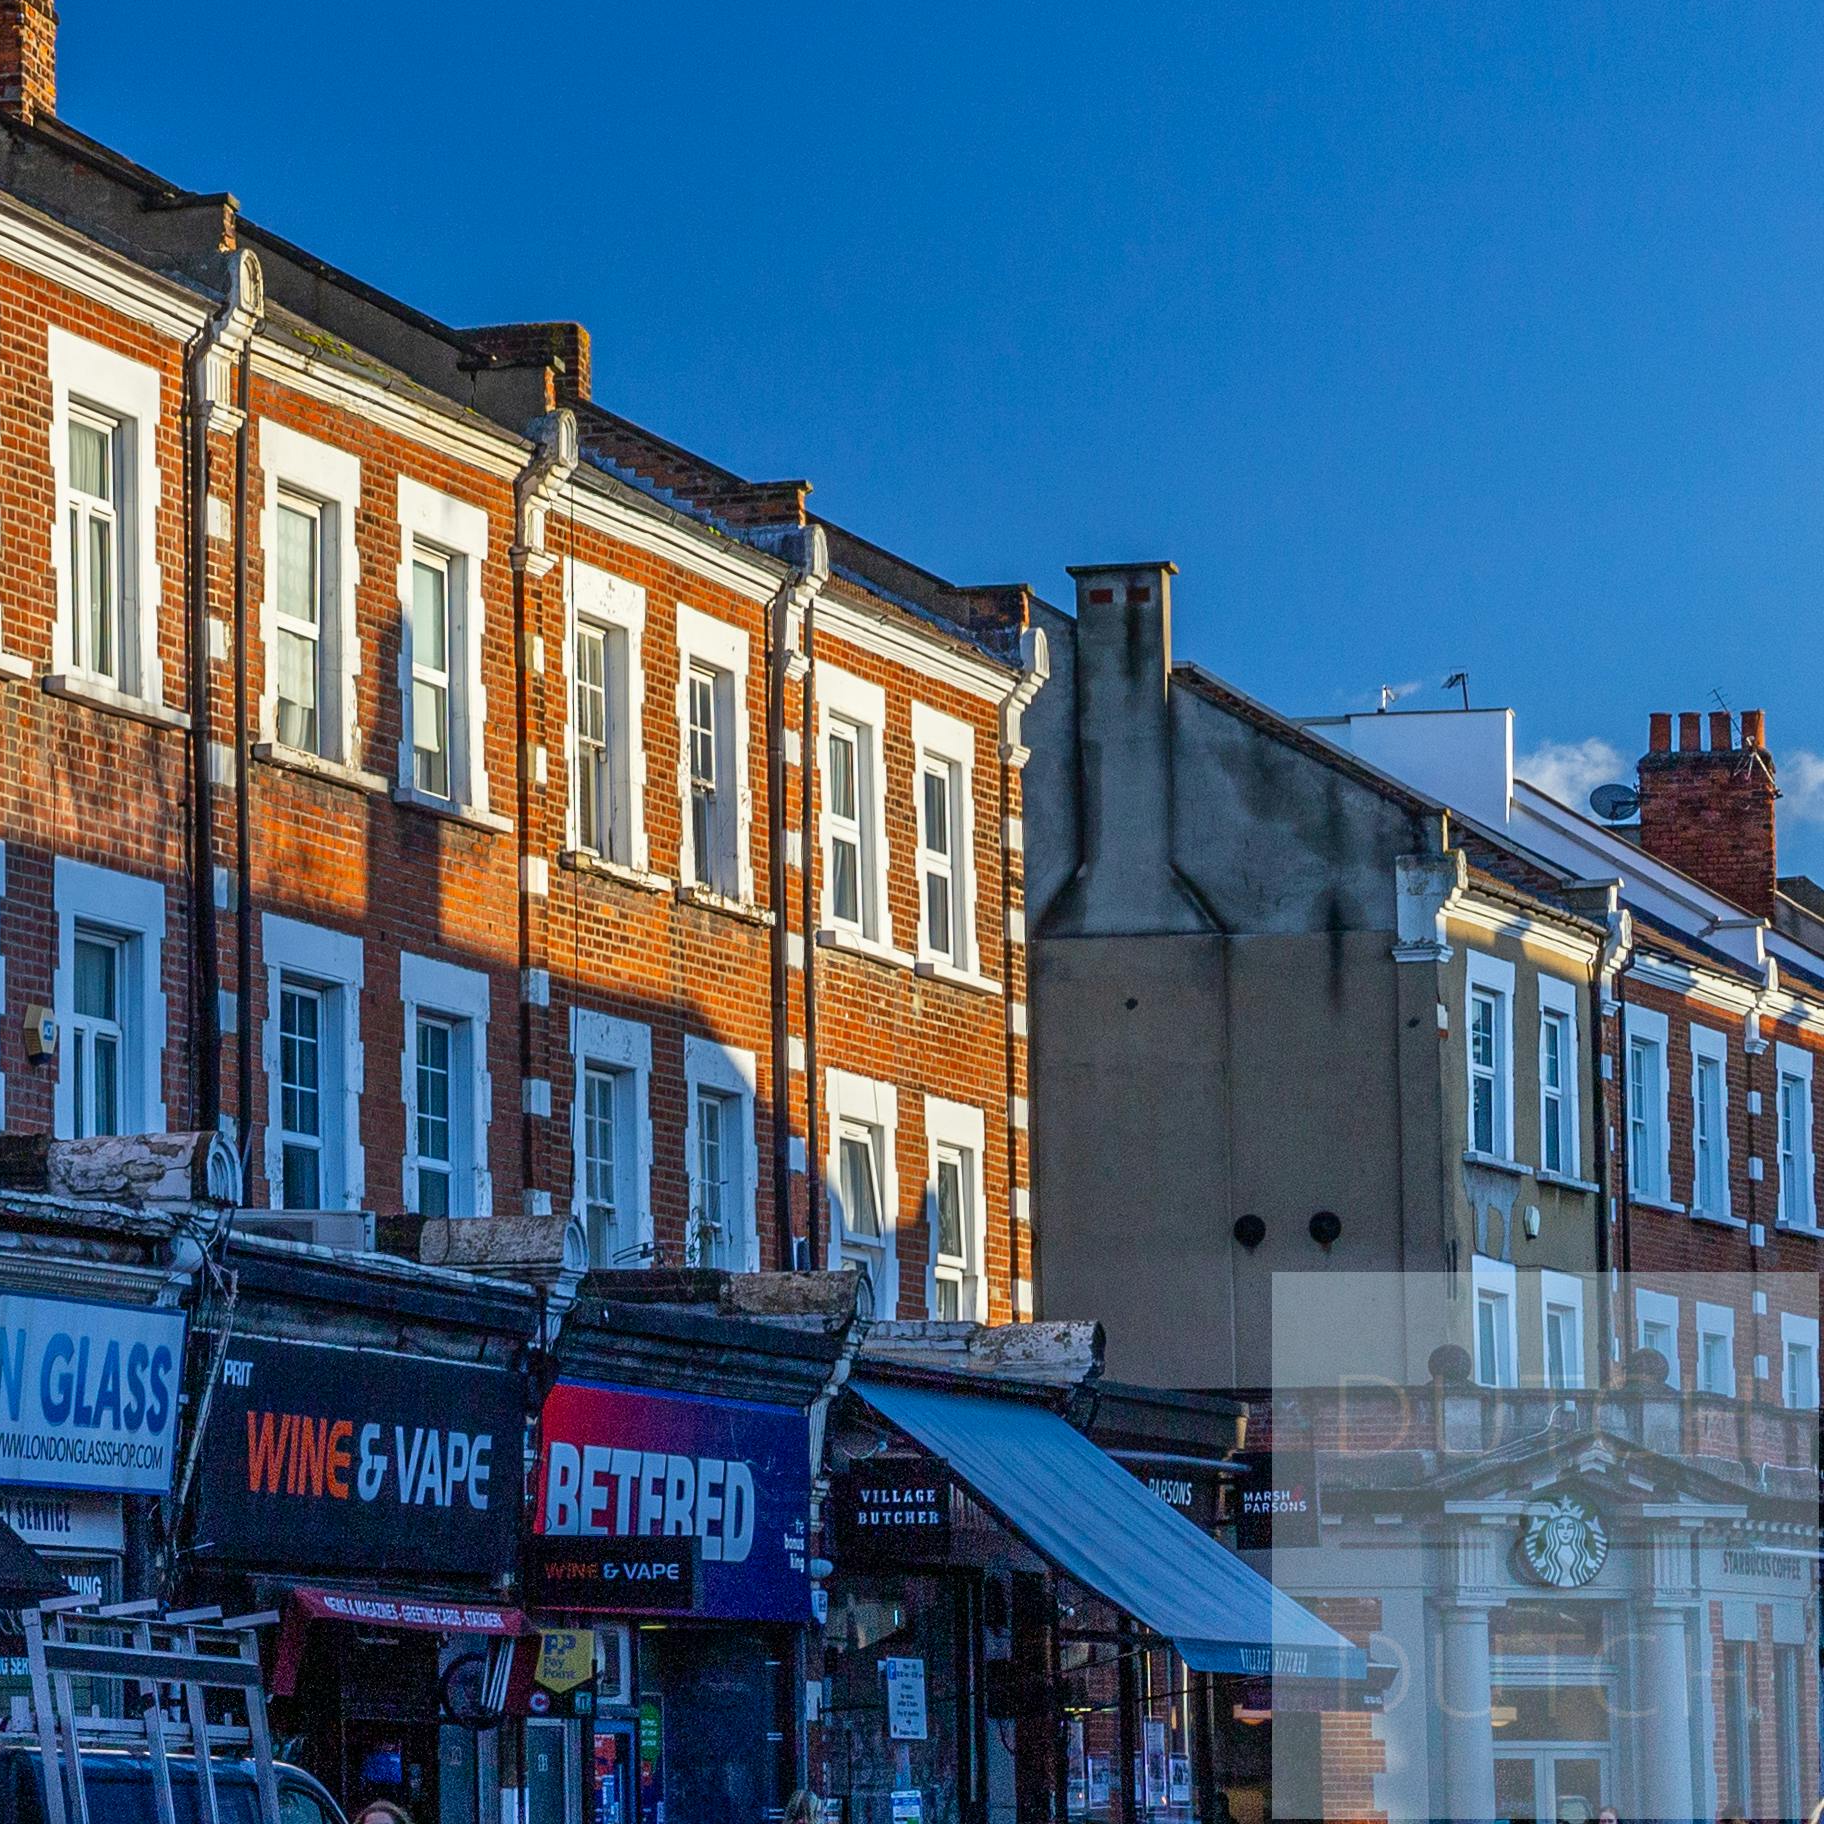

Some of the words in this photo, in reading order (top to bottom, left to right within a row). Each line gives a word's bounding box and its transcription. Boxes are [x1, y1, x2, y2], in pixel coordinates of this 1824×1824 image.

[40, 1332, 172, 1435] GLASS
[223, 1359, 253, 1387] PRIT
[247, 1410, 353, 1501] WINE
[357, 1422, 388, 1503] &
[394, 1425, 492, 1511] VAPE
[547, 1441, 755, 1563] BETFRED
[860, 1489, 936, 1504] VILLAGE
[1243, 1489, 1291, 1503] MARSH
[1243, 1500, 1307, 1514] PARSONS
[17, 1498, 71, 1533] SERVICE
[858, 1510, 940, 1525] BUTCHER
[602, 1563, 620, 1579] &
[623, 1562, 680, 1580] VAPE
[1723, 1550, 1771, 1577] STARBUCKS
[1772, 1554, 1802, 1580] COFFEE
